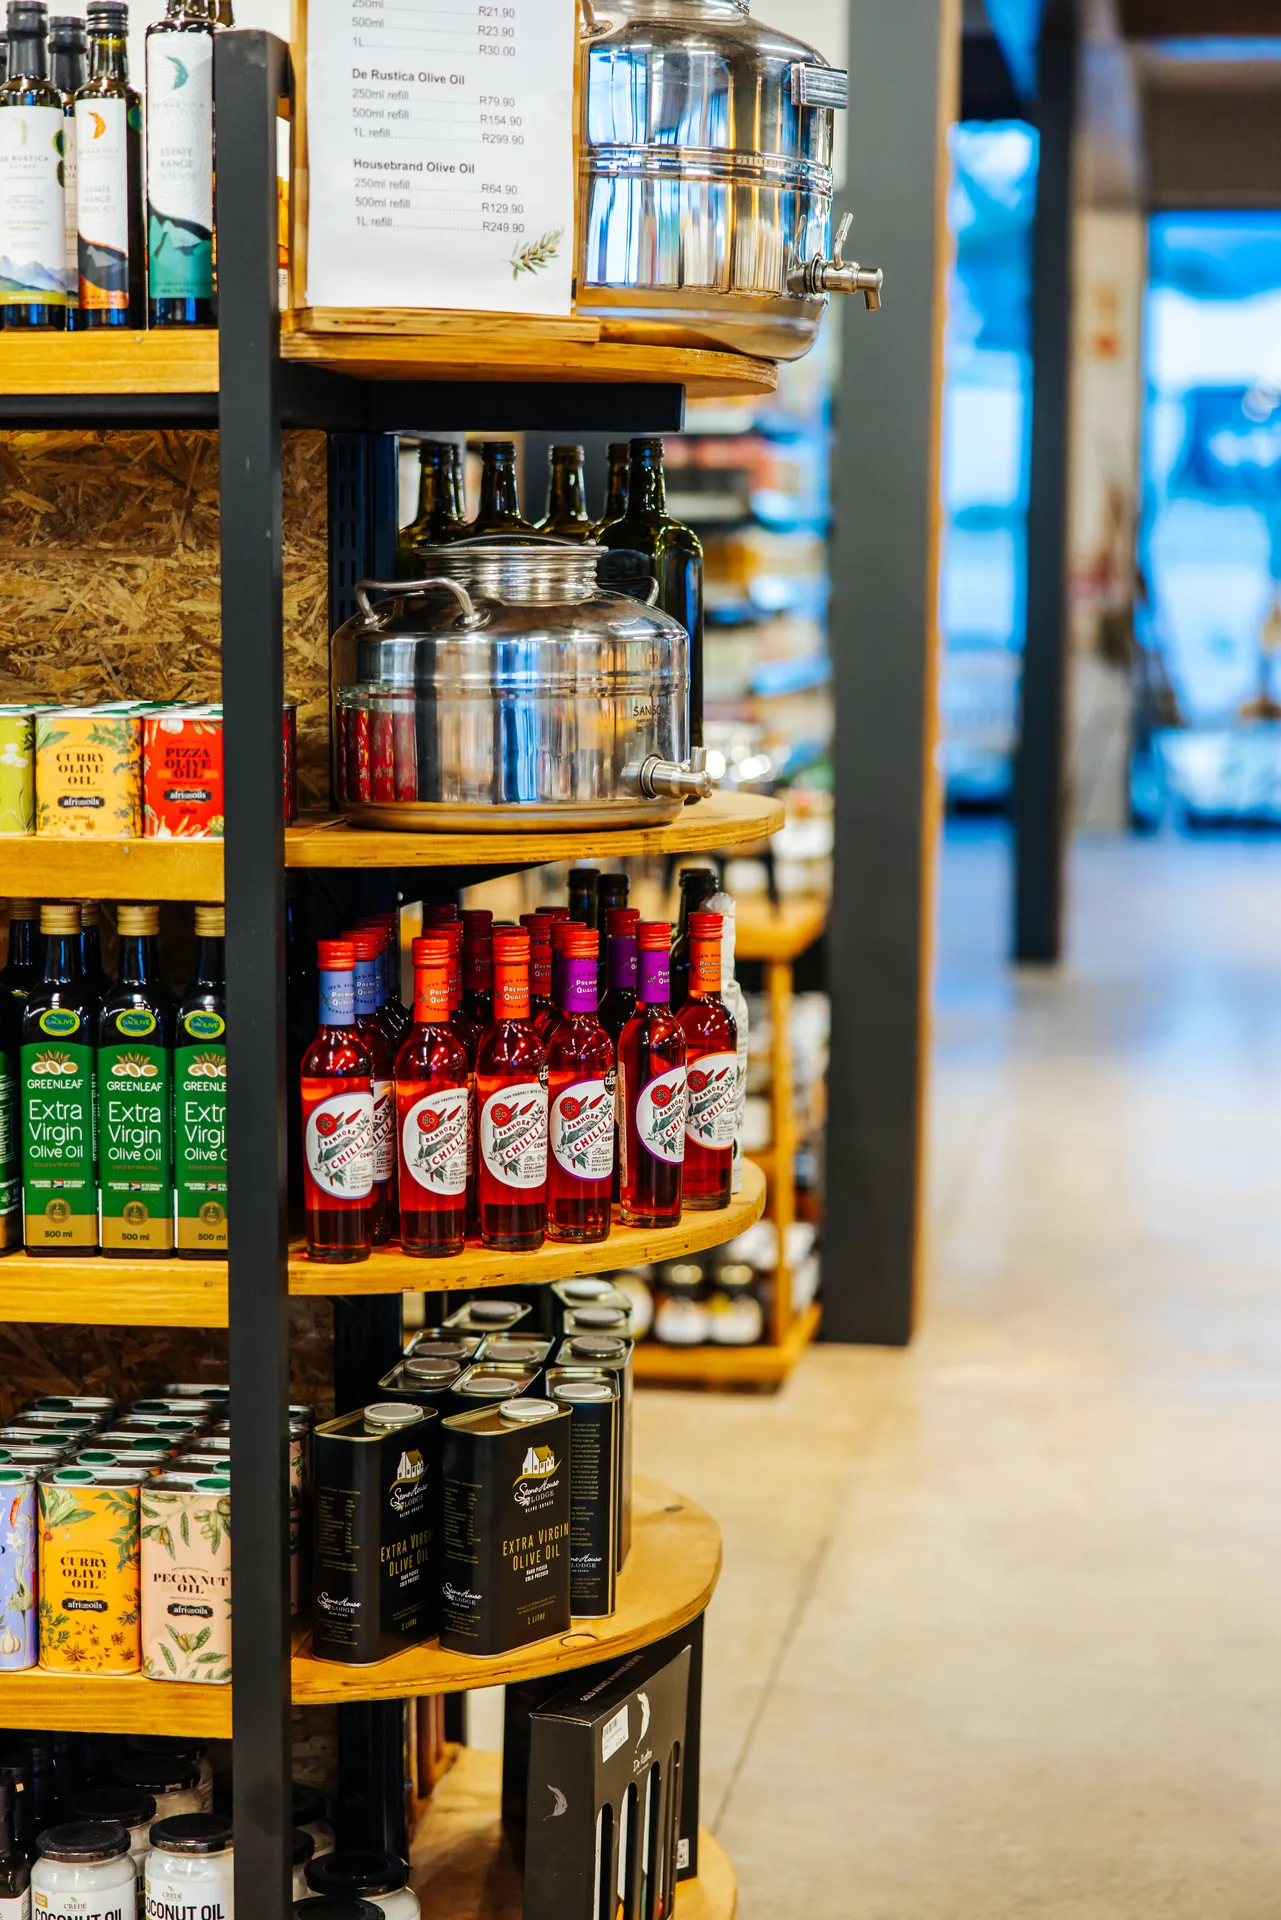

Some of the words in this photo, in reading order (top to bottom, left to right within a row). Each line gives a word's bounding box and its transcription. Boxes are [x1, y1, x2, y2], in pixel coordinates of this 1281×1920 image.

[478, 6, 515, 18] R21.90
[352, 16, 384, 29] 500ml
[478, 25, 514, 38] R23.90
[352, 36, 364, 48] 1L
[478, 44, 516, 57] R30.00
[352, 68, 368, 80] De
[370, 69, 415, 82] Rustica
[418, 72, 446, 84] Olive
[450, 74, 465, 86] Oil
[352, 88, 384, 100] 250ml
[387, 90, 410, 101] refill
[478, 96, 516, 108] R79.90
[352, 108, 384, 120] 500ml
[387, 109, 410, 120] refill
[480, 114, 522, 127] R154.90
[353, 128, 366, 138] 1L
[368, 128, 391, 139] refill
[482, 133, 524, 146] R299.90
[160, 159, 194, 169] RANGE
[353, 158, 423, 172] Housebrand
[426, 161, 456, 174] Olive
[458, 162, 475, 174] Oil
[354, 178, 386, 190] 250ml
[388, 179, 410, 190] refill
[481, 184, 518, 196] R64.90
[355, 196, 387, 208] 500ml
[389, 198, 411, 210] refill
[482, 202, 524, 215] R129.90
[356, 216, 368, 227] 1L
[370, 216, 393, 228] refill
[482, 222, 525, 234] R249.90
[56, 753, 104, 762] CURRY
[165, 748, 210, 758] PIZZA
[58, 764, 104, 774] OLIVE
[164, 759, 212, 770] OLIVE
[68, 776, 96, 786] OIL
[173, 768, 203, 779] OIL
[27, 1078, 84, 1090] GREENLEAF
[106, 1080, 164, 1092] GREENLEAF
[183, 1080, 227, 1092] GREENLE
[694, 1085, 725, 1102] BANHOEK
[28, 1099, 83, 1120] Extra
[108, 1101, 162, 1124] Extra
[185, 1101, 226, 1124] Extr
[700, 1093, 731, 1122] CHILLI
[498, 1119, 531, 1137] BANHOEK
[567, 1113, 600, 1130] BANHOEK
[665, 1112, 685, 1138] CHIL
[28, 1122, 83, 1146] Virgin
[108, 1124, 162, 1148] Virgin
[184, 1124, 226, 1148] Virgi
[324, 1129, 357, 1147] BANHOEK
[372, 1121, 391, 1144] ILLI
[425, 1125, 457, 1144] BANHOEK
[573, 1122, 607, 1152] CHILLI
[431, 1133, 463, 1166] CHILLI
[505, 1127, 540, 1159] CHILLI
[29, 1145, 63, 1159] Olive
[65, 1145, 84, 1159] Oil
[108, 1148, 141, 1161] Olive
[144, 1148, 162, 1162] Oil
[184, 1148, 218, 1161] Olive
[330, 1137, 366, 1169] CHILLI
[44, 1230, 61, 1238] 500
[62, 1230, 73, 1238] ml
[122, 1233, 138, 1241] 500
[140, 1233, 150, 1241] ml
[198, 1233, 214, 1241] 500
[216, 1233, 226, 1241] ml
[404, 1494, 424, 1508] LODGE
[530, 1490, 555, 1503] LODGE
[380, 1540, 408, 1563] EXTRA
[410, 1528, 432, 1550] VIRGI
[502, 1534, 534, 1557] EXTRA
[538, 1522, 570, 1544] VIRGIN
[60, 1556, 109, 1569] CURRY
[389, 1554, 414, 1577] OLIVE
[416, 1547, 429, 1564] OIL
[512, 1550, 541, 1572] OLIVE
[545, 1542, 561, 1560] OIL
[62, 1569, 107, 1580] OLIVE
[153, 1572, 197, 1584] PECAN
[200, 1575, 228, 1587] NUT
[71, 1579, 99, 1590] OIL
[177, 1584, 204, 1595] OIL
[331, 1605, 355, 1614] LODGE
[454, 1596, 476, 1606] LODGE
[532, 1612, 546, 1623] LITRE
[63, 1902, 87, 1910] CREDÉ
[145, 1896, 197, 1920] OCONUT
[201, 1903, 225, 1920] OIL
